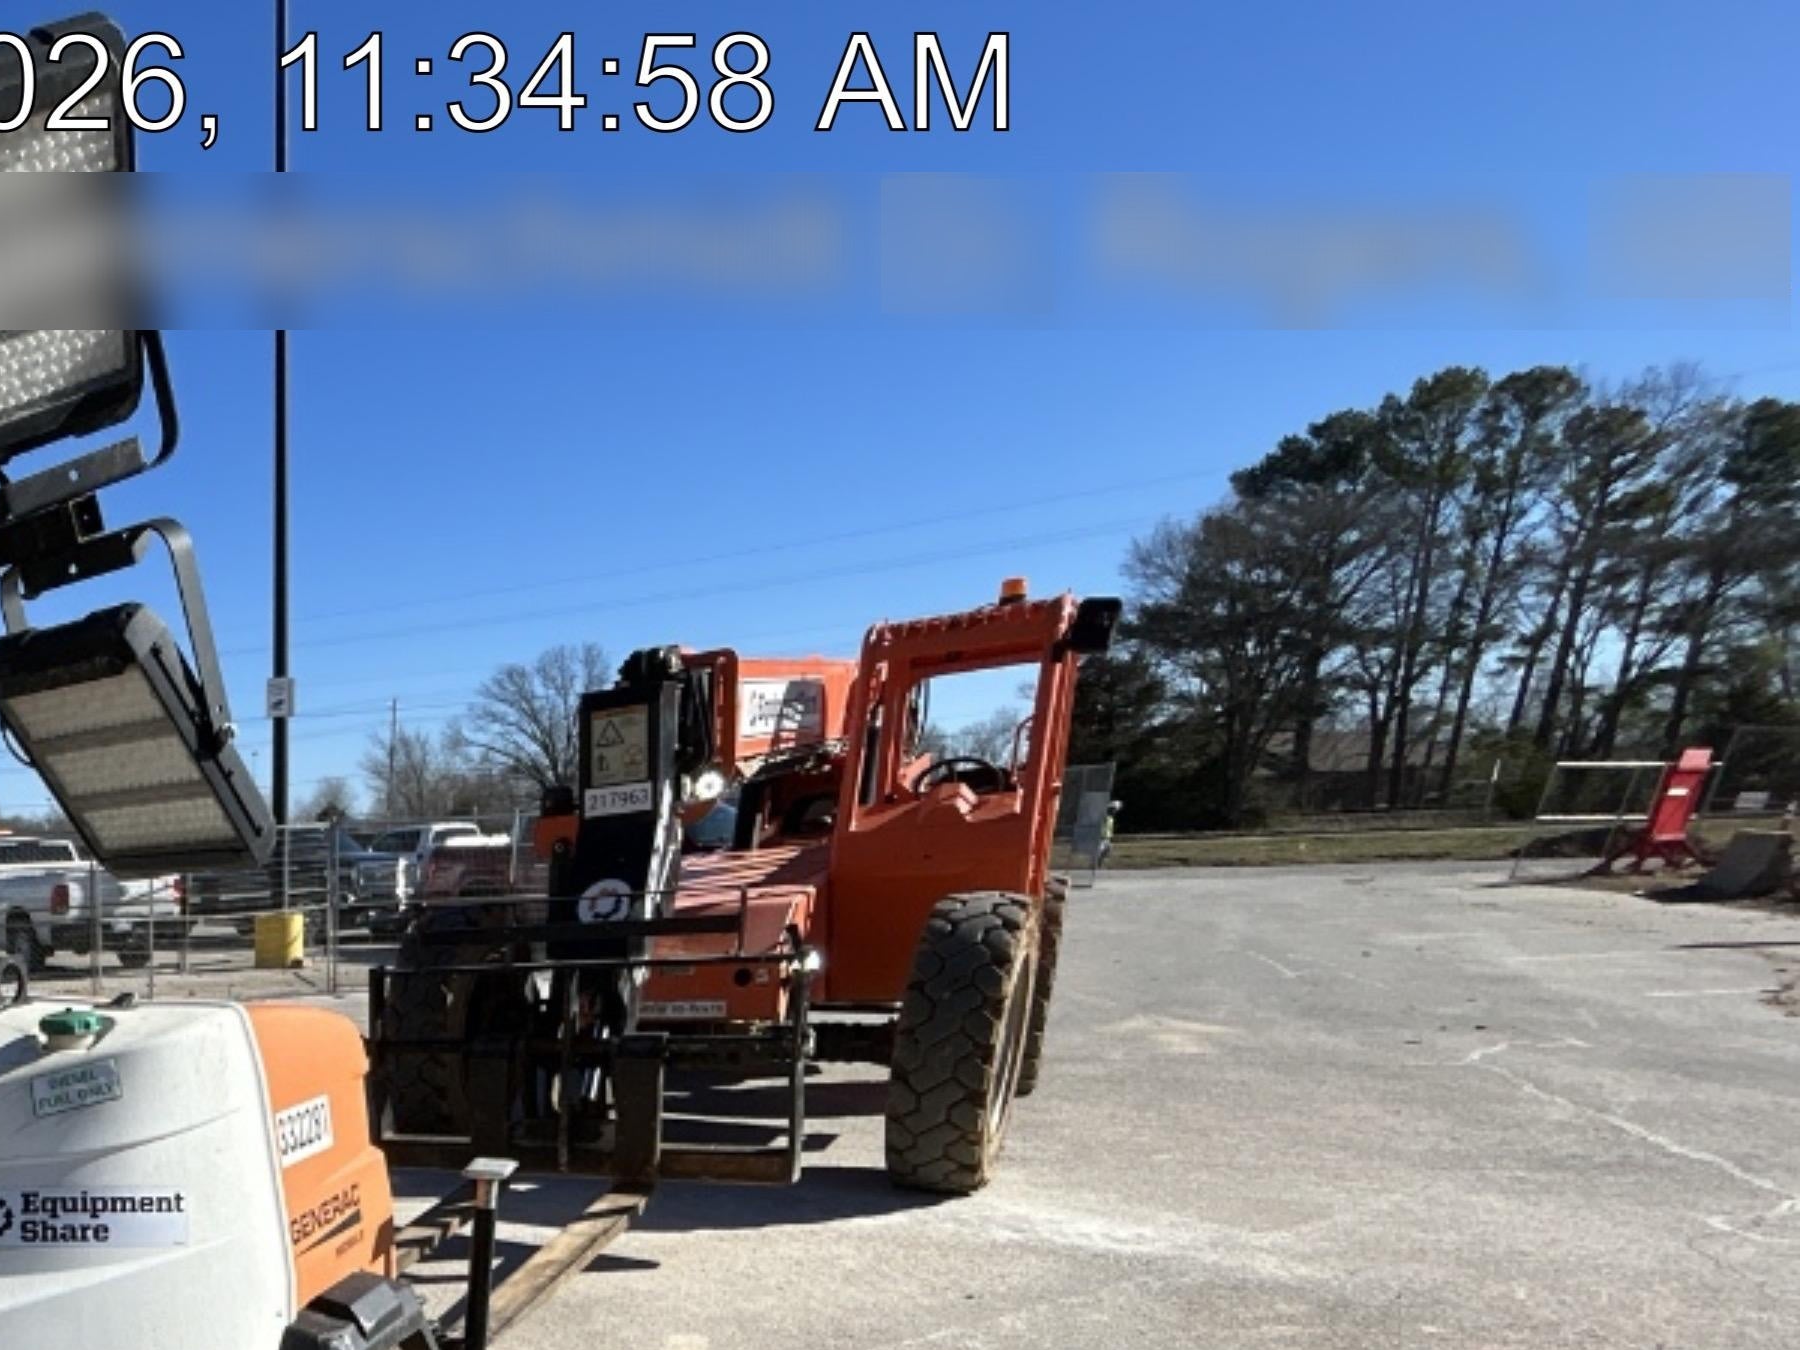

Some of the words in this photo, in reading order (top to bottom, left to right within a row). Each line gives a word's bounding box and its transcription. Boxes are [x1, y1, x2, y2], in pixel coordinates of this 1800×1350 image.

[20, 1191, 185, 1219] Equipment
[290, 1179, 361, 1246] GENERAC
[20, 1220, 110, 1243] Share
